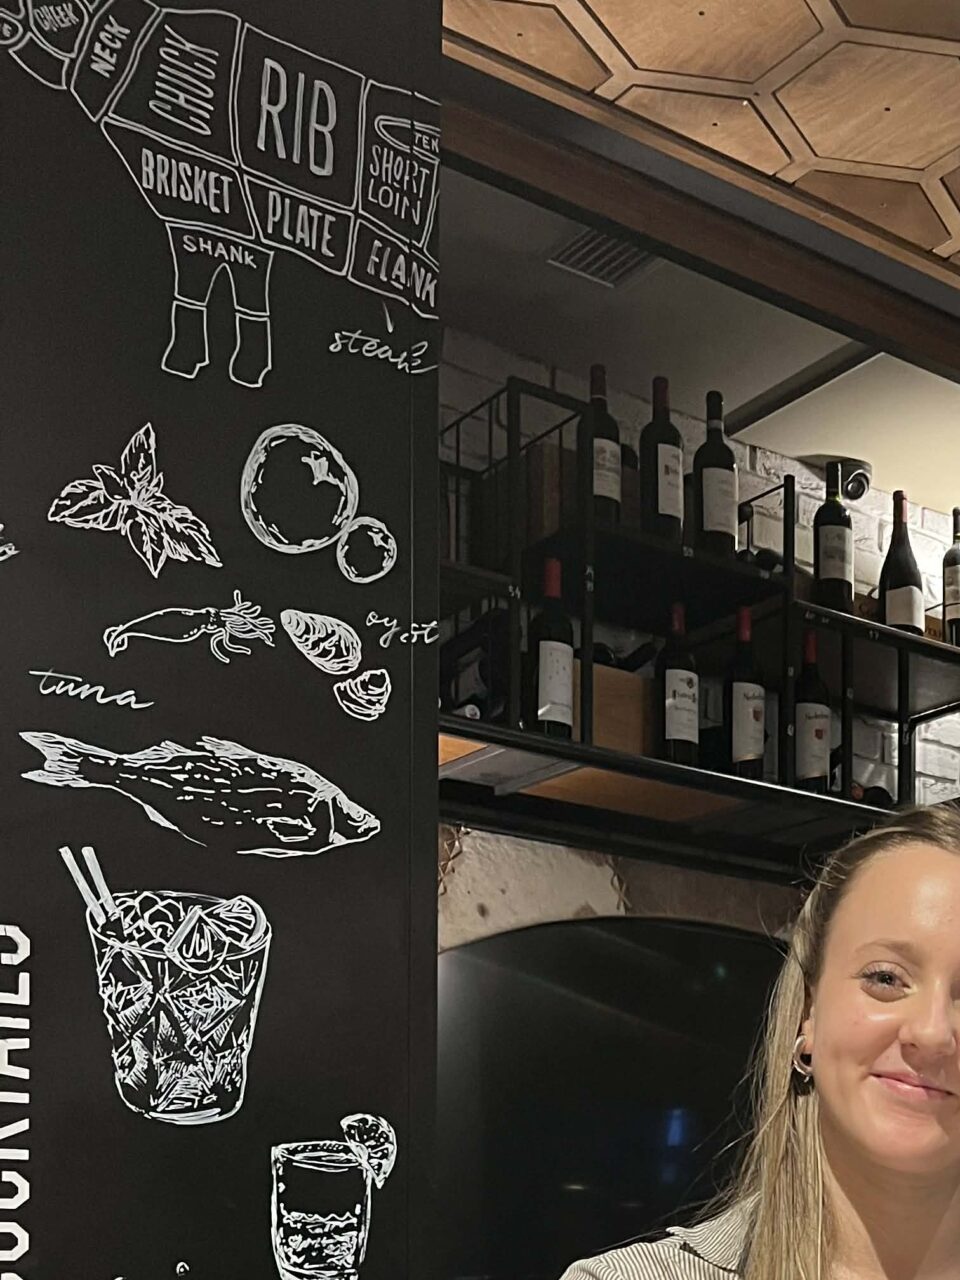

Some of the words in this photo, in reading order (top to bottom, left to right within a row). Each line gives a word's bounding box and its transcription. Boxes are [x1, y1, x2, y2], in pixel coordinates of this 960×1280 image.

[90, 14, 131, 78] NECK
[149, 24, 219, 136] CHUCK
[257, 57, 337, 176] RIB
[141, 147, 233, 214] BRISKET
[368, 178, 421, 226] LOIN
[370, 144, 430, 199] SHORT
[183, 235, 256, 269] SHANK
[267, 190, 336, 257] PLATE
[366, 239, 438, 308] FLANK
[29, 669, 155, 709] tuna
